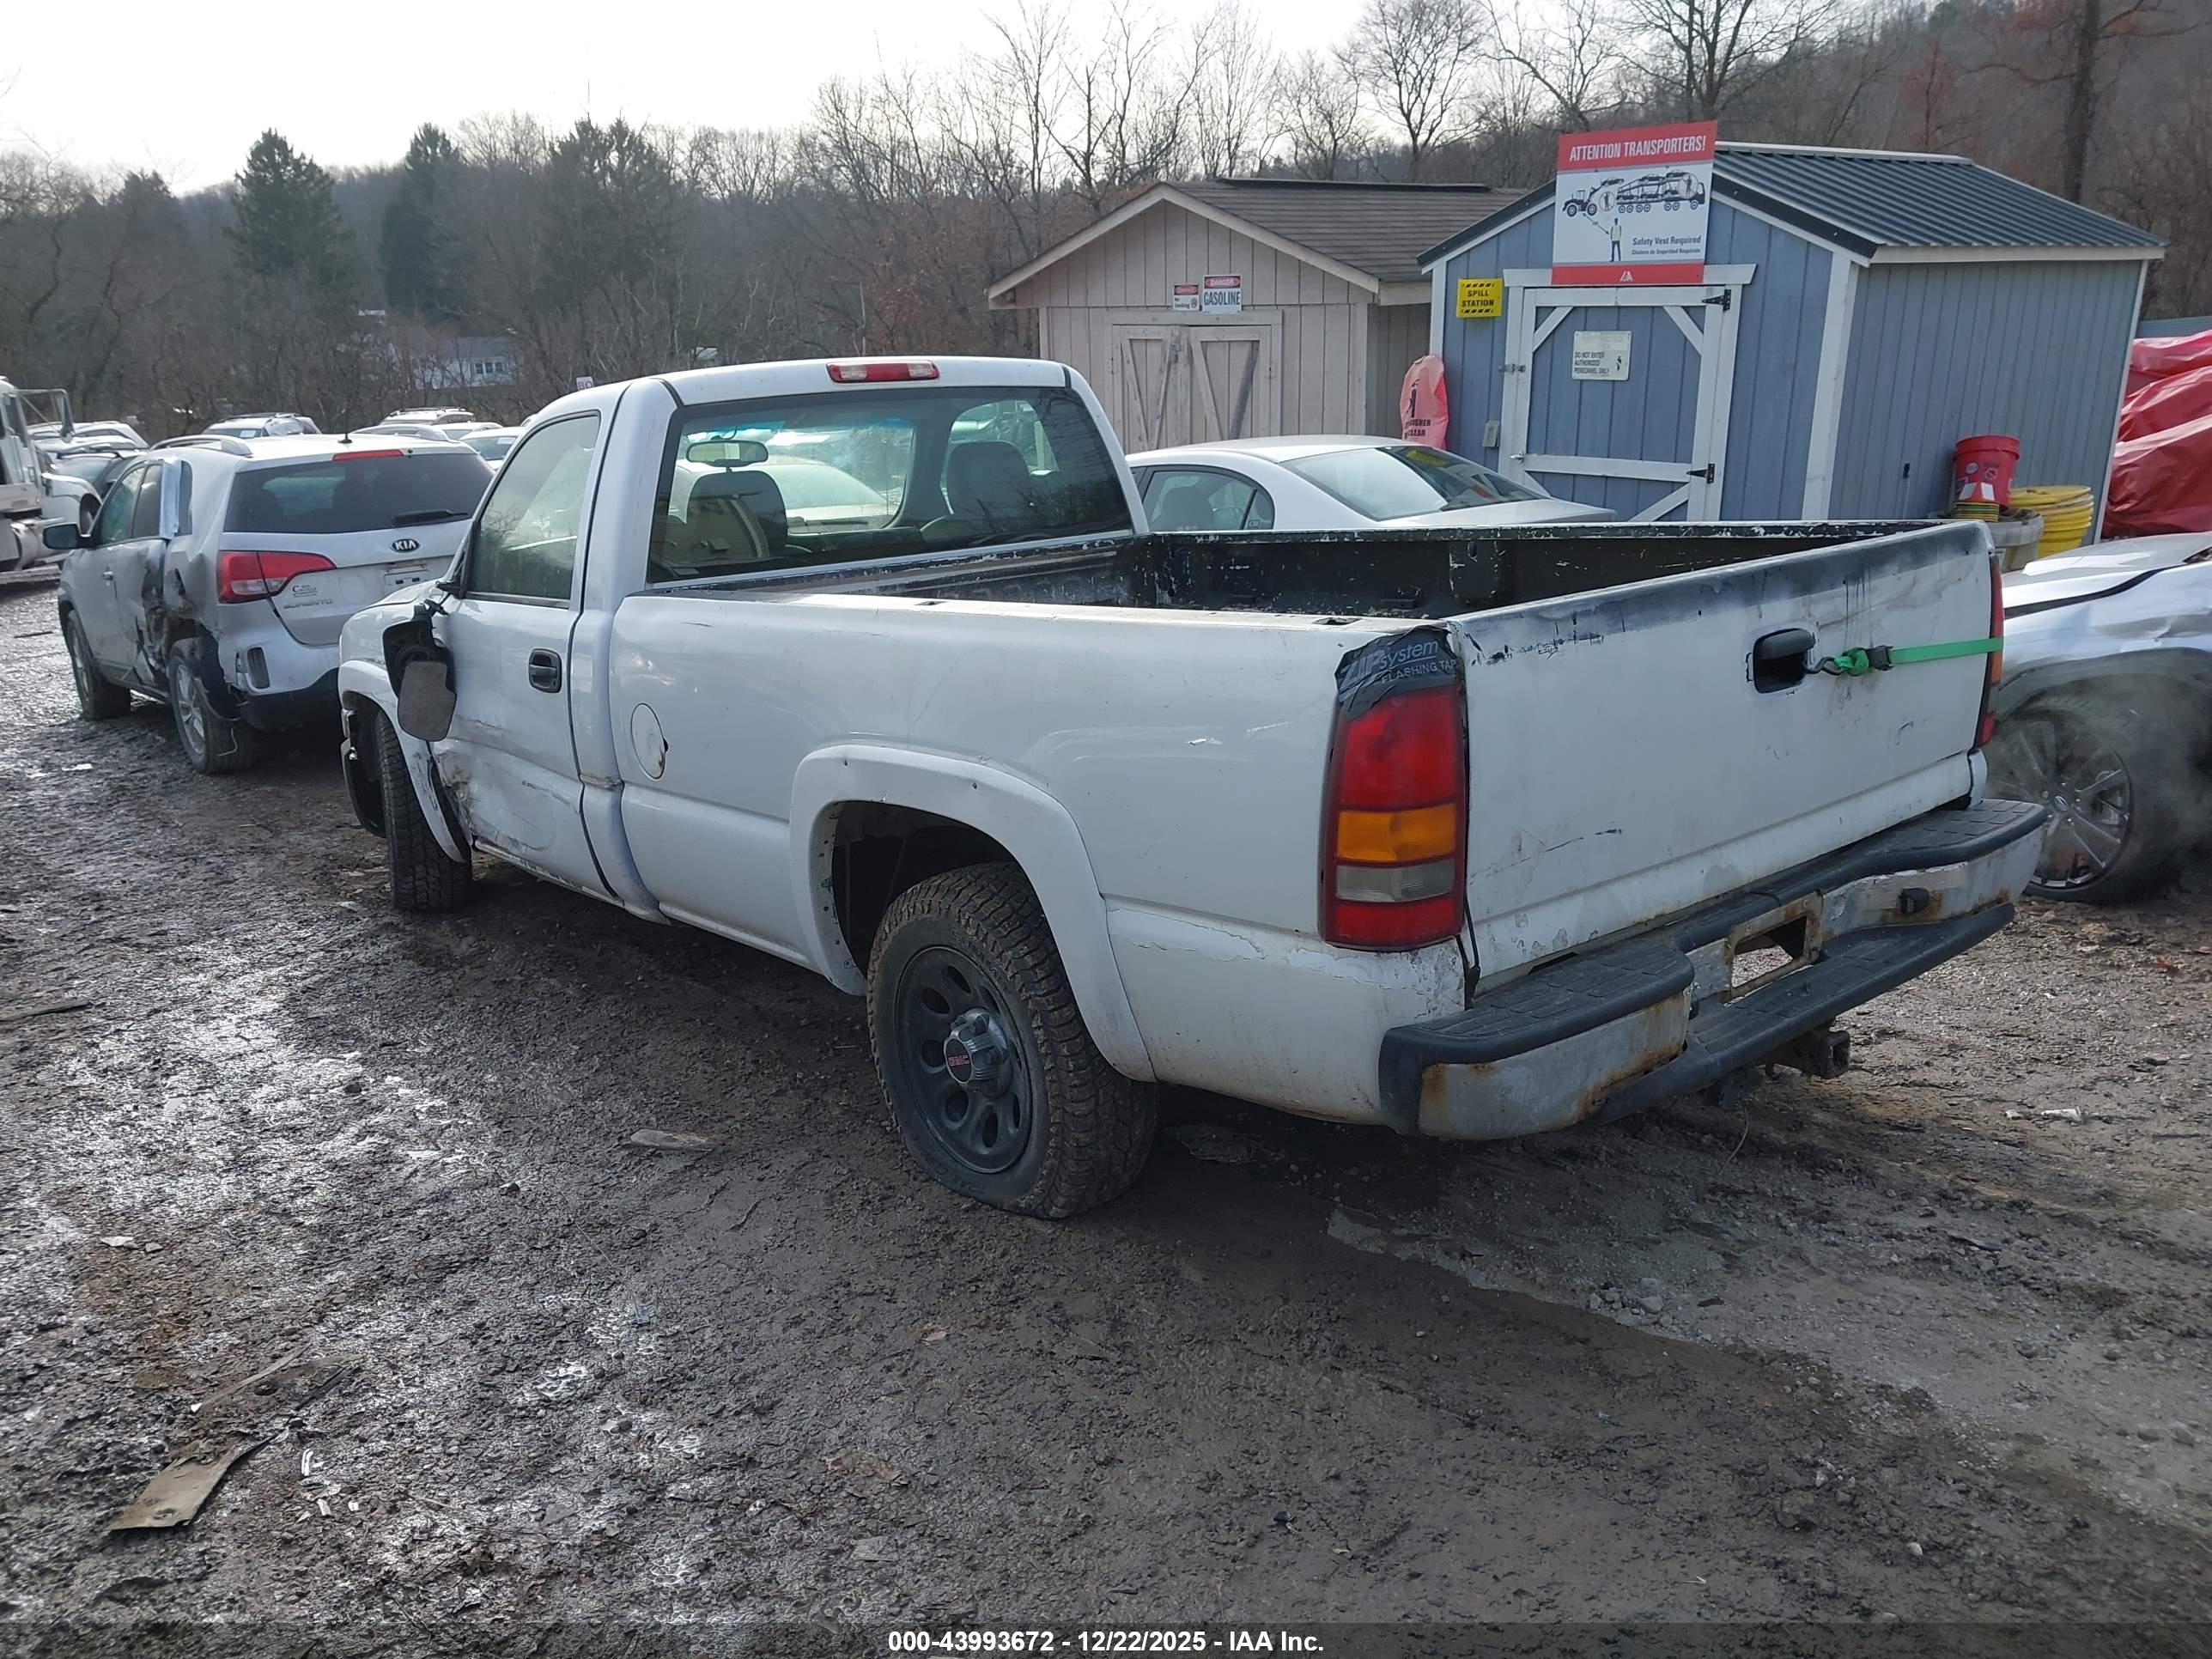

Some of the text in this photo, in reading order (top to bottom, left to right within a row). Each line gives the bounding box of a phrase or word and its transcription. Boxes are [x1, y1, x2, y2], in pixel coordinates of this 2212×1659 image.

[1570, 136, 1706, 161] ATTENTION TRANSPORTERS!
[1632, 234, 1701, 246] Safety Vest Required
[1204, 291, 1240, 306] GASOLINE
[1462, 299, 1494, 307] STATION
[395, 540, 416, 550] KIA
[1381, 662, 1438, 684] FLASHING
[947, 1055, 969, 1066] GMC
